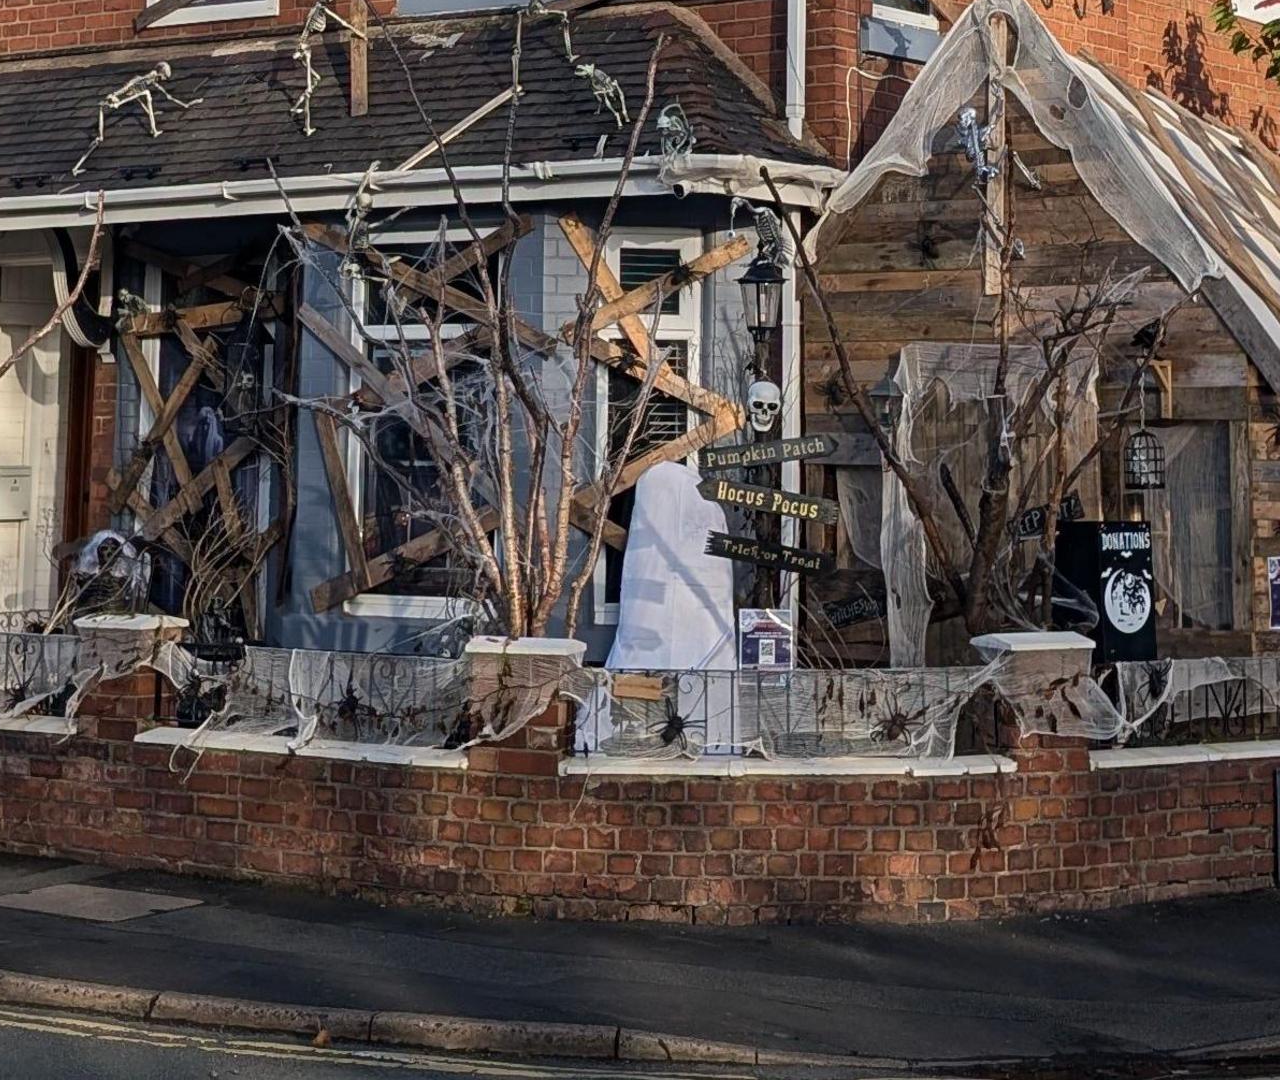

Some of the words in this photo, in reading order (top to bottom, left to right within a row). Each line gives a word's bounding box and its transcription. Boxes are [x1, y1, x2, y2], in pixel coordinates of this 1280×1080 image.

[706, 444, 776, 467] Pumpkin
[782, 438, 825, 458] Patch
[1101, 531, 1150, 551] DONATIONS
[764, 551, 777, 561] or
